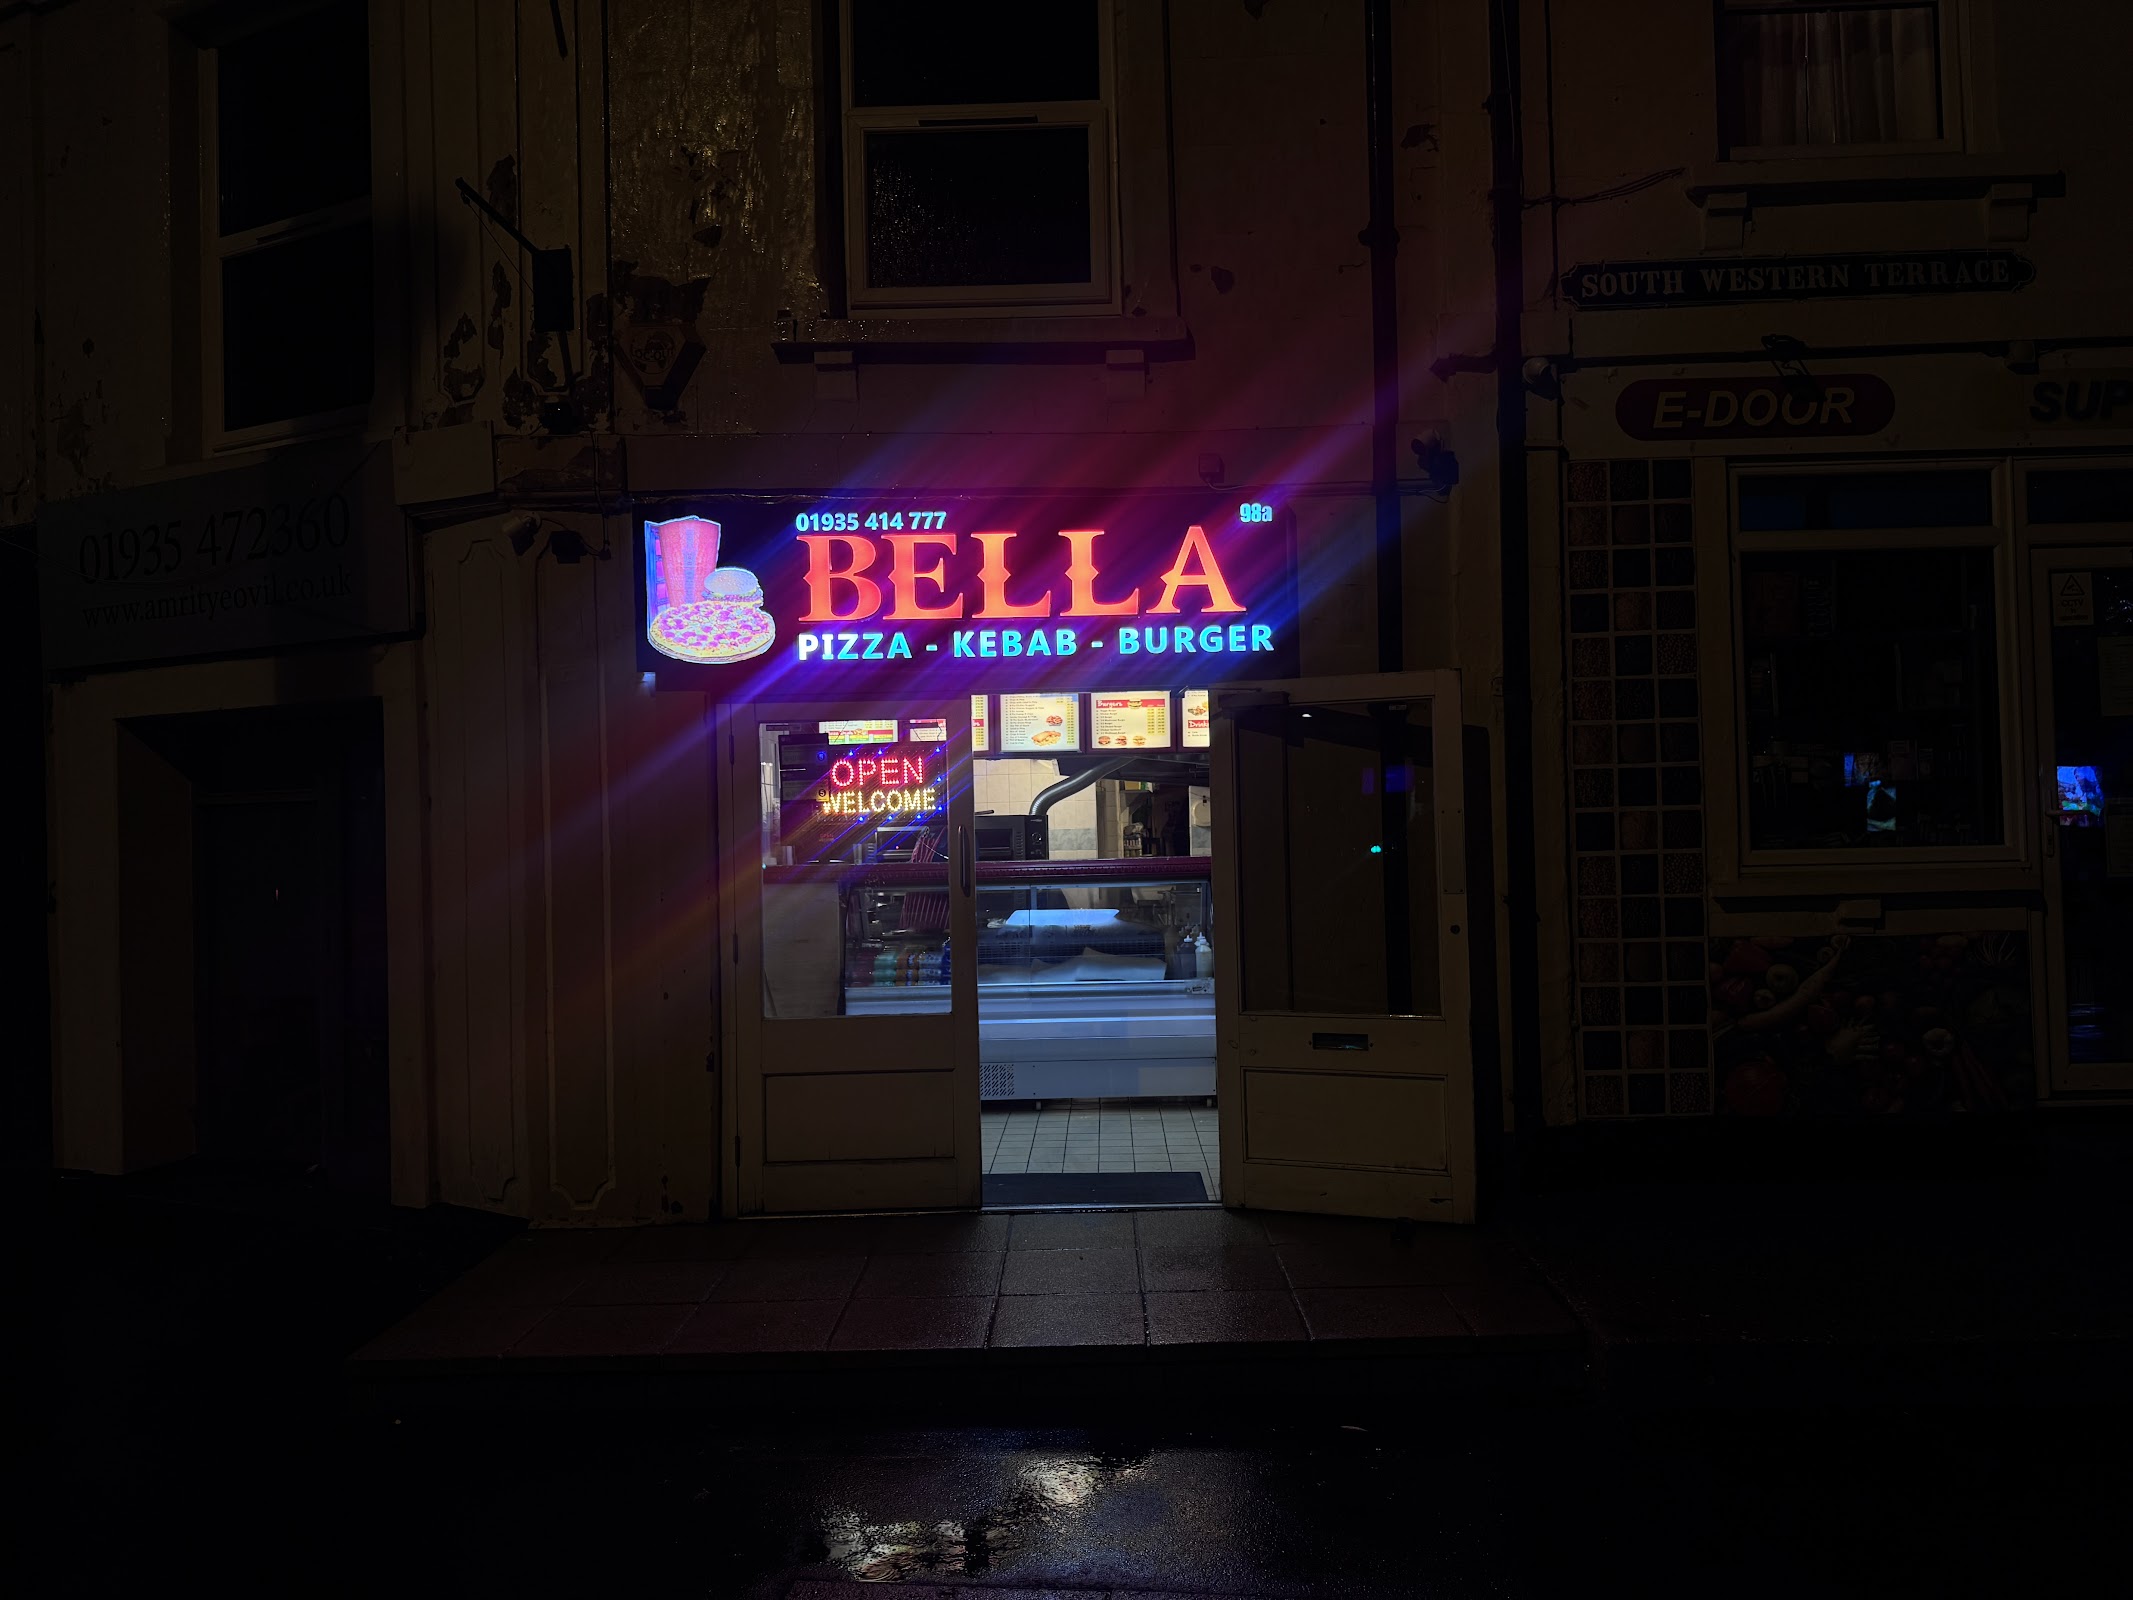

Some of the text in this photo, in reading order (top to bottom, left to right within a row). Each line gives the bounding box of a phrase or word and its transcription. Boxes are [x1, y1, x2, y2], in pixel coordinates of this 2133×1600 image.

[1581, 257, 2010, 298] SOUTH WESTERN TERRACE
[1652, 386, 1856, 430] E-DOOR
[795, 511, 947, 531] 01935 414 777
[1239, 503, 1273, 523] 98a
[80, 494, 349, 584] 01935 472360
[796, 525, 1248, 622] BELLA
[83, 565, 352, 629] www.amrityeovil.co.uk
[798, 633, 913, 661] PIZZA
[953, 630, 1078, 659] KEBAB
[1119, 624, 1275, 656] BURGER
[1097, 700, 1123, 710] Burgers
[831, 757, 923, 787] OPEN
[823, 788, 936, 814] WELCOME
